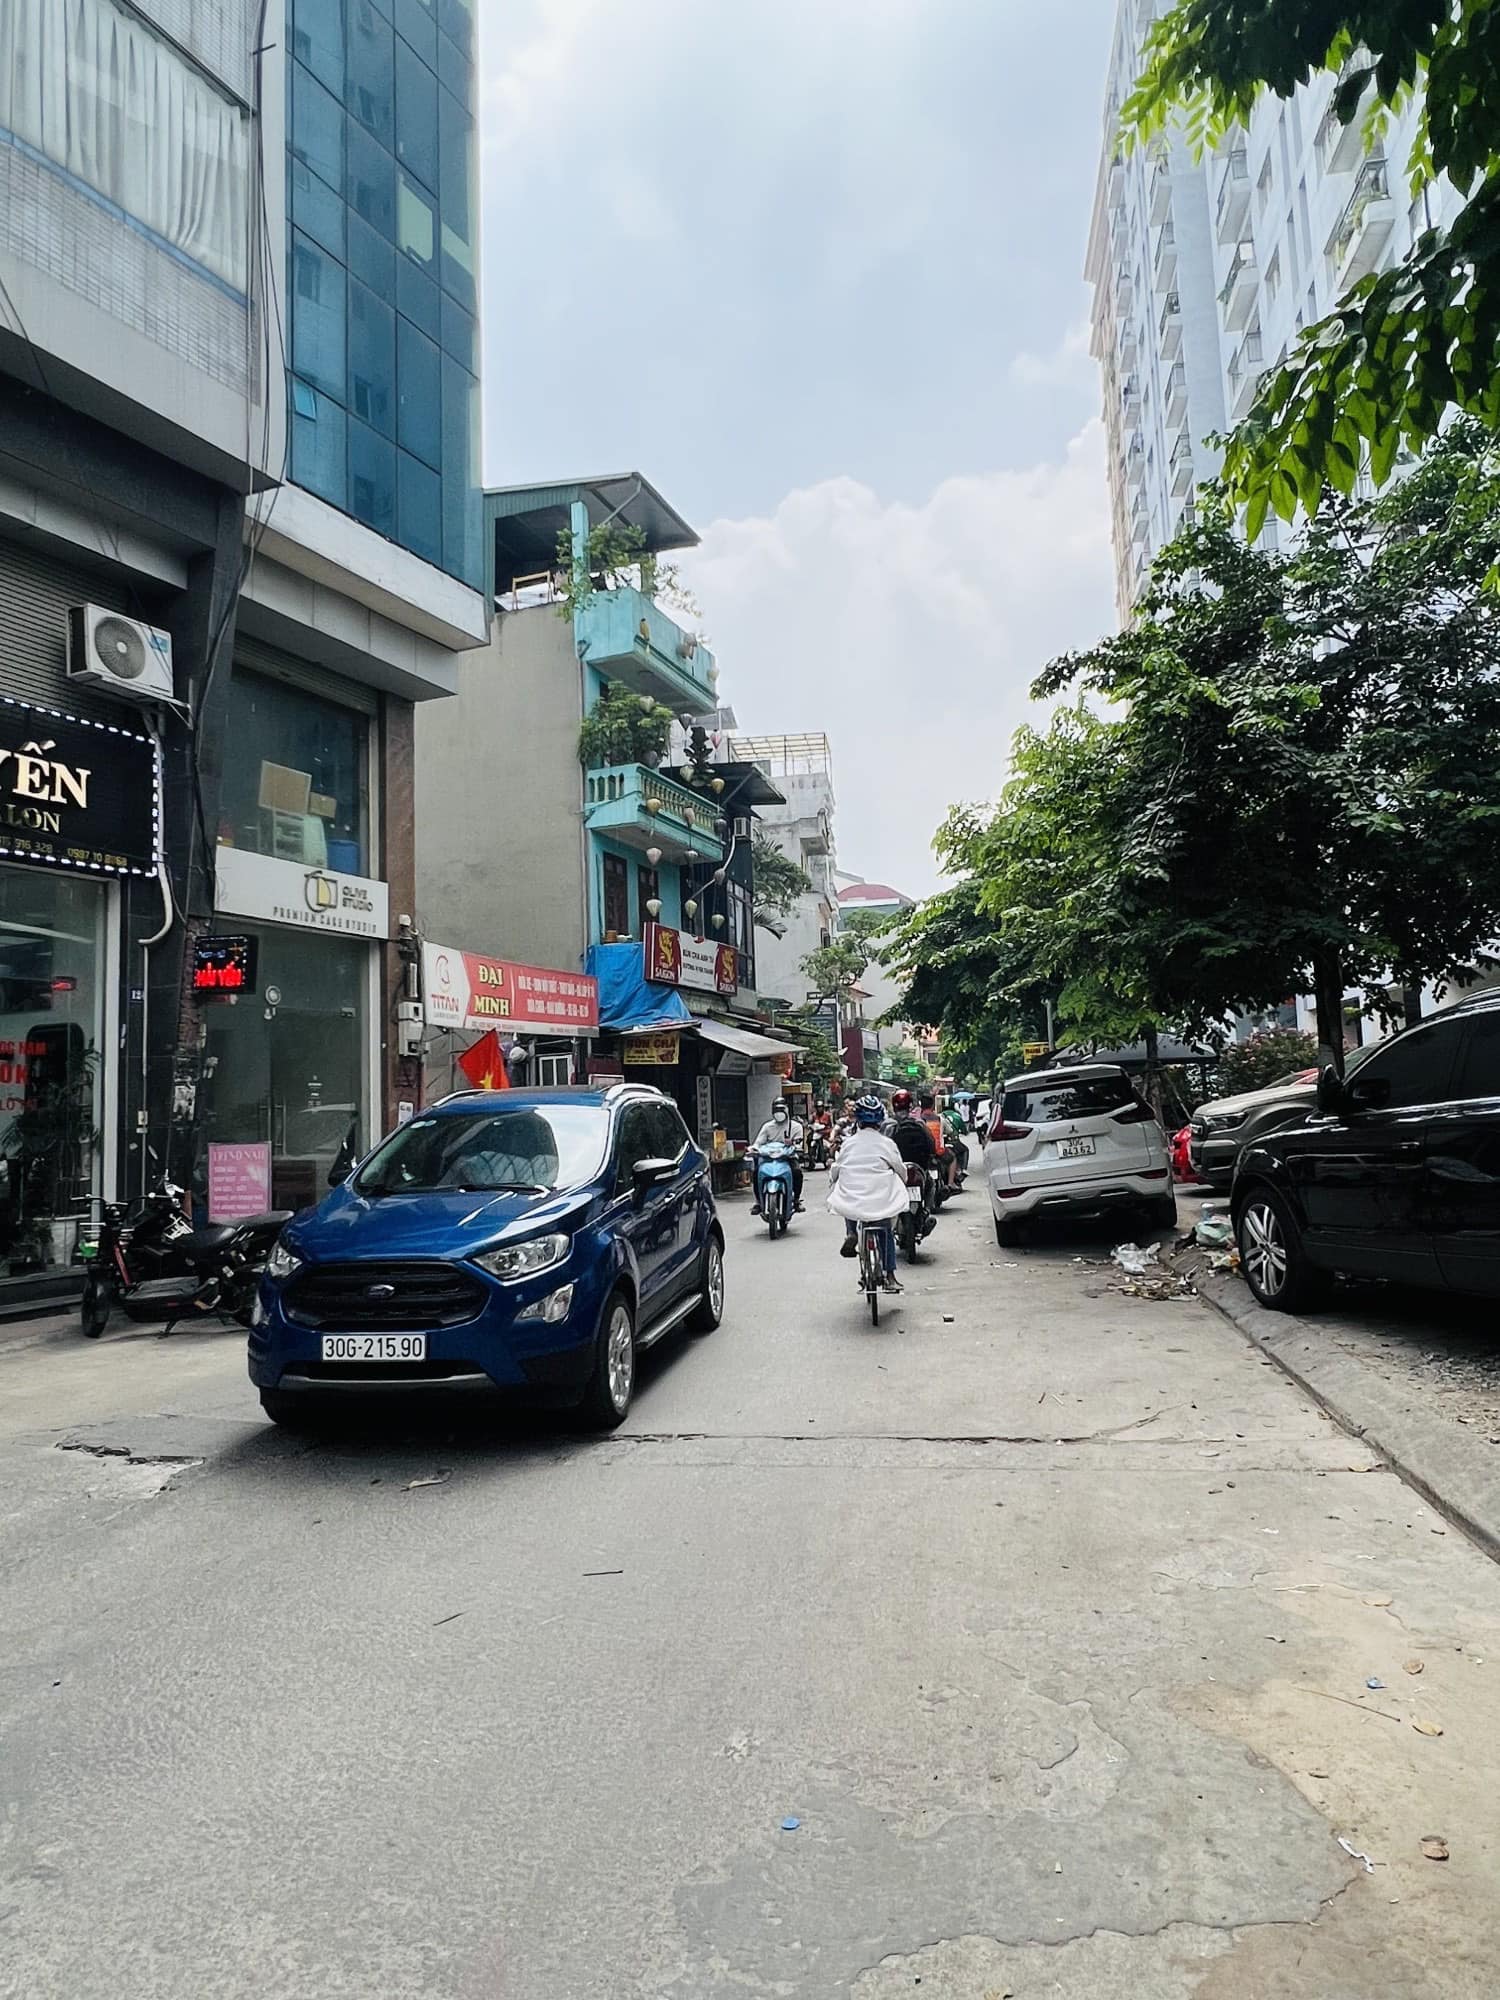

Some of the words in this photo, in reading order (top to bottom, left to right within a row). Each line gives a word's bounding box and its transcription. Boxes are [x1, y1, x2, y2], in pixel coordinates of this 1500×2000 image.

[0, 803, 61, 833] LON
[342, 897, 373, 912] STUDIO
[478, 964, 504, 989] ĐẠI
[431, 993, 459, 1012] TITAN
[474, 994, 510, 1017] MINH
[325, 1337, 422, 1358] 30G-215.90
